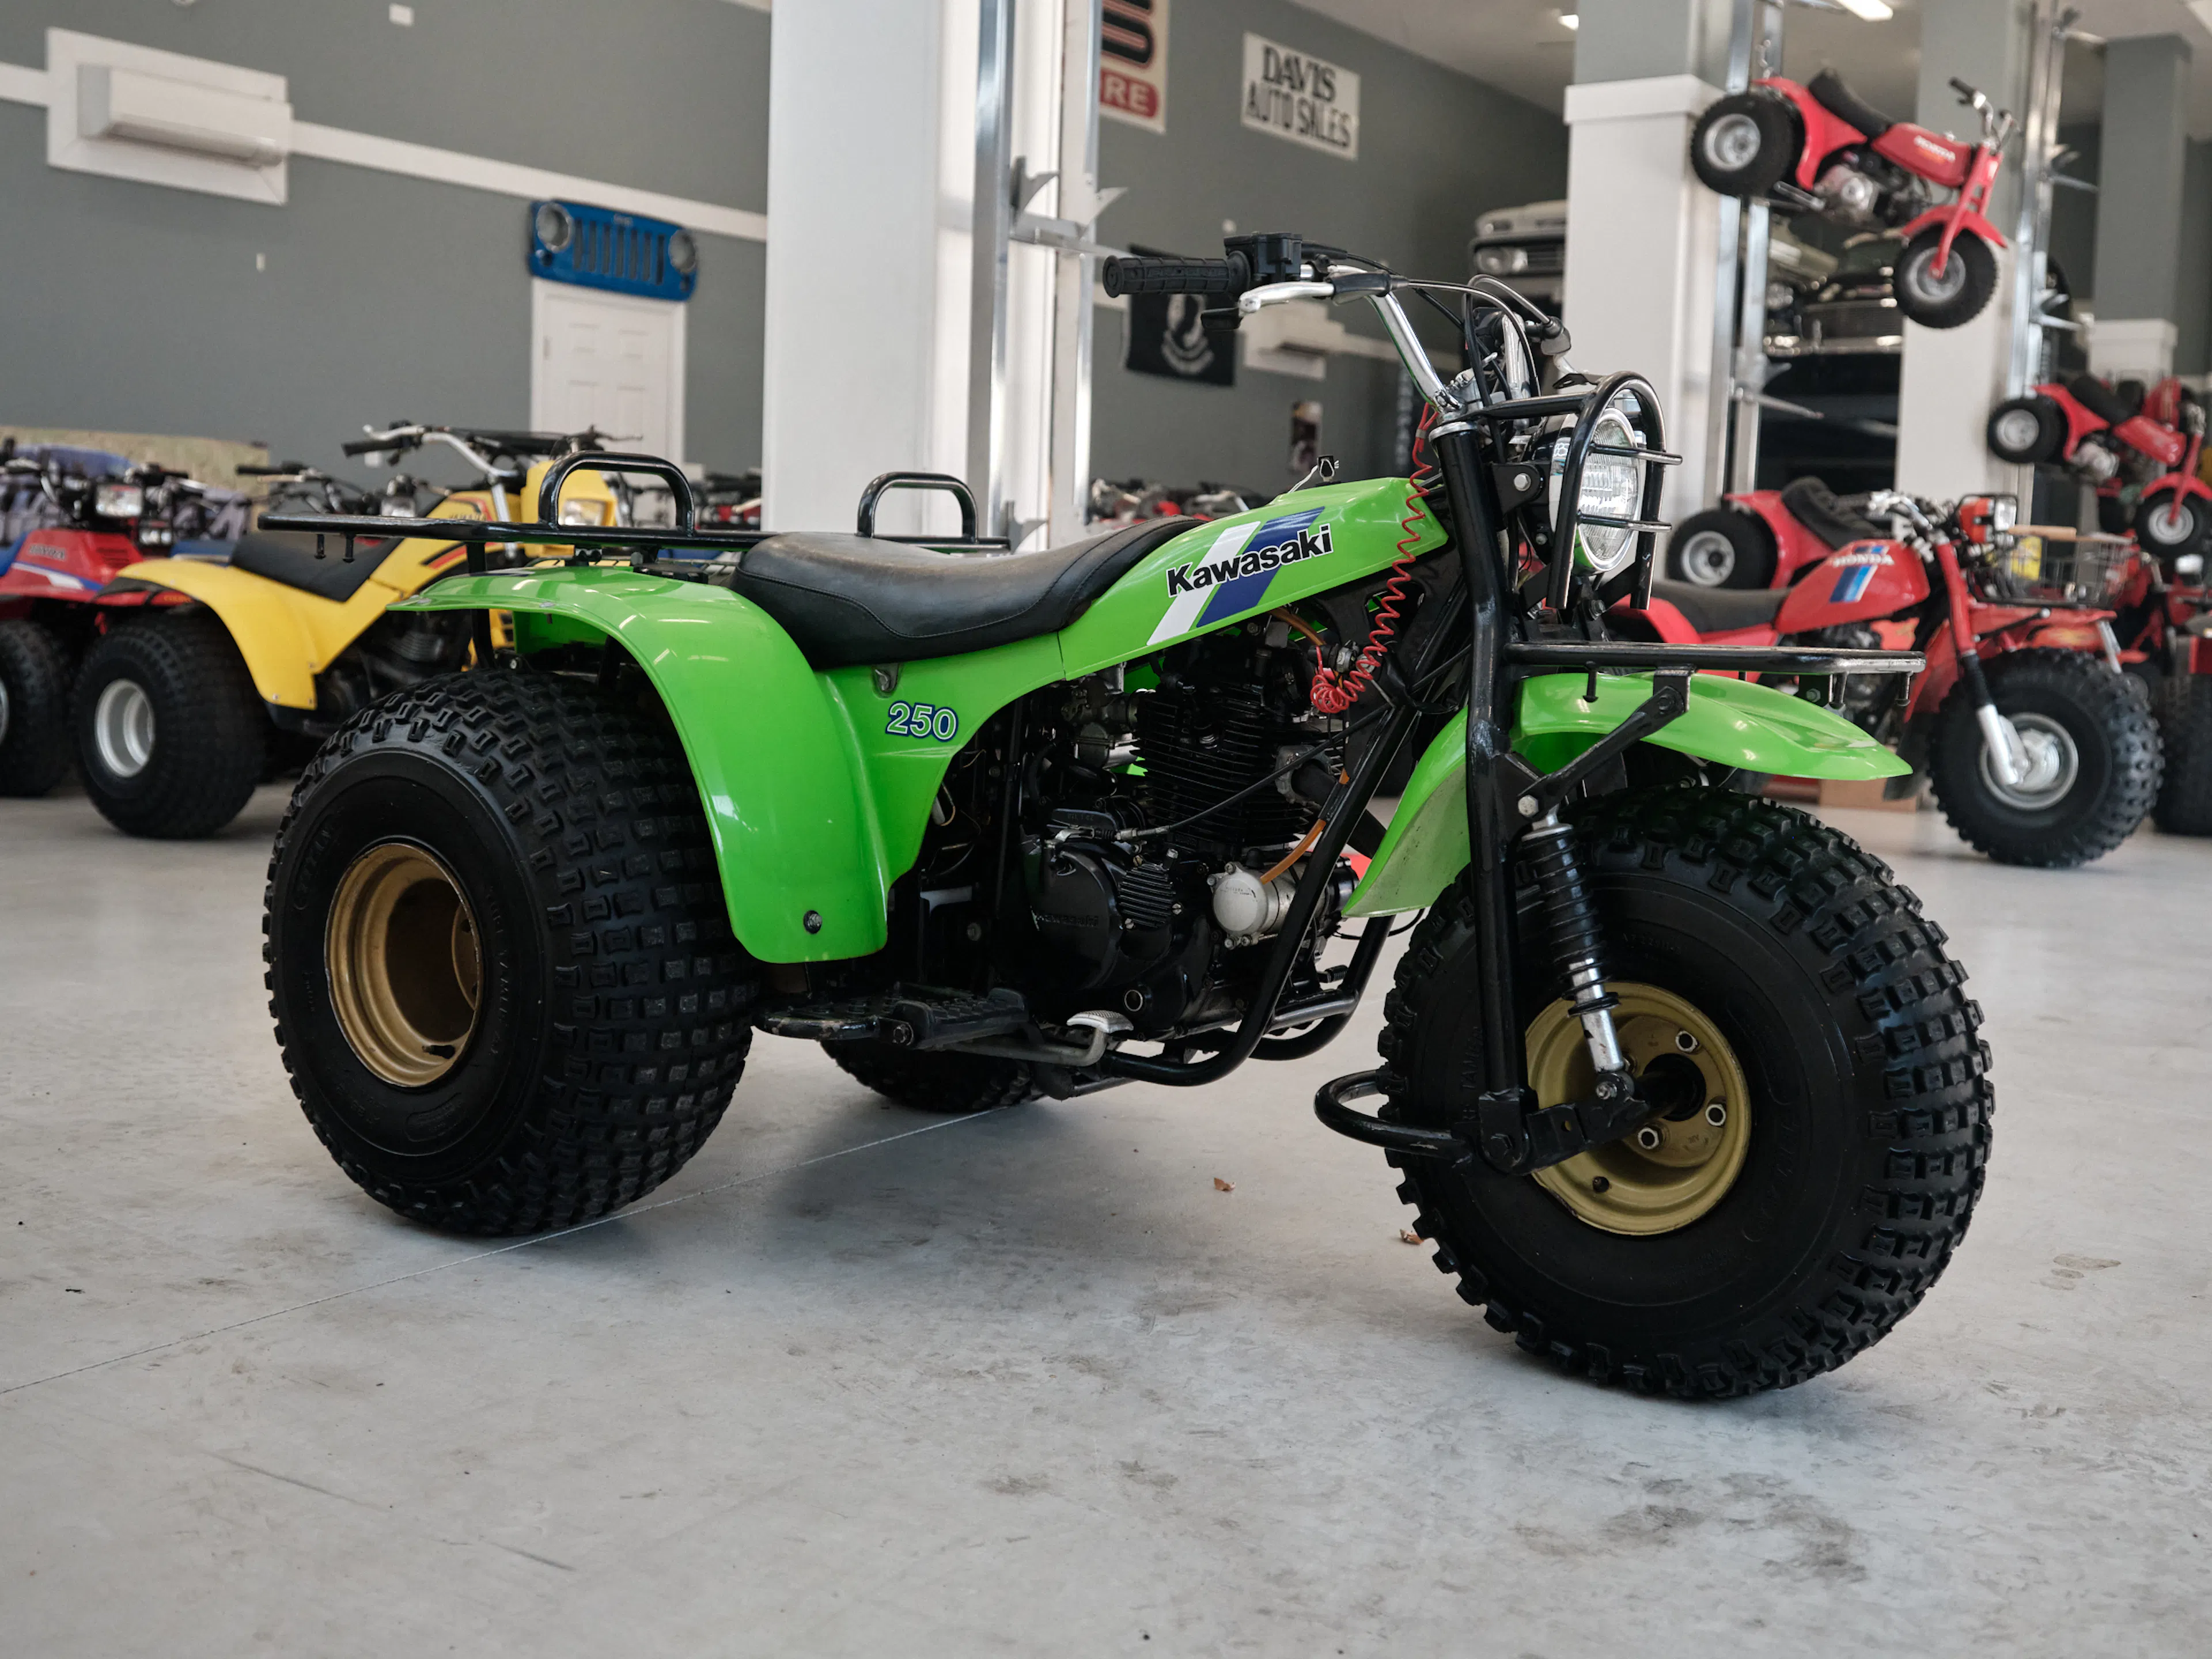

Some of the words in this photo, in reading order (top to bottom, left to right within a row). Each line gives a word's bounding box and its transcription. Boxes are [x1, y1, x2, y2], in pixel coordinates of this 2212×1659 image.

[1263, 45, 1336, 103] DAVIS
[1246, 81, 1293, 130] AUTO
[1298, 97, 1351, 149] SALES
[1166, 523, 1334, 598] Kawasaki
[1832, 553, 1895, 567] HONDA
[885, 700, 959, 742] 250
